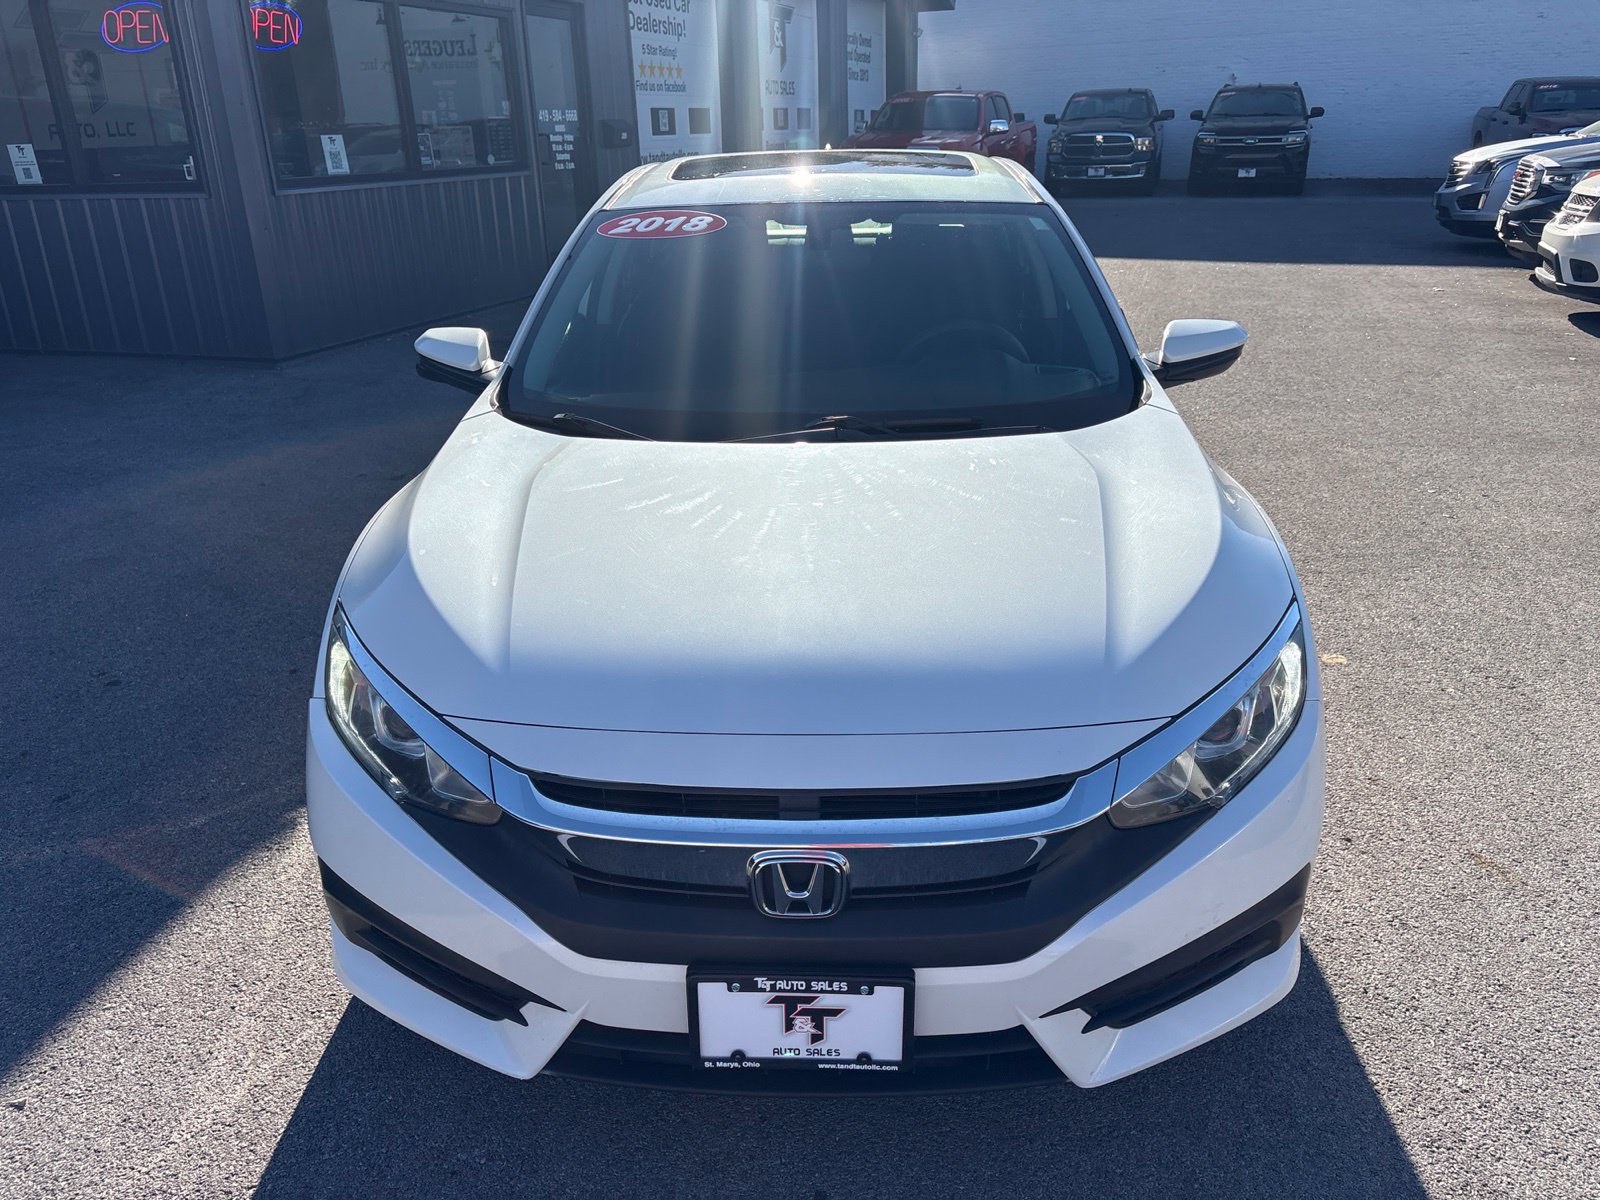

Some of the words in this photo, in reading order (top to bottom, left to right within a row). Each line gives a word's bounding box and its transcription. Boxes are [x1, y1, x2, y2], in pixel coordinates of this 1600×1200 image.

[103, 10, 169, 43] OPEN
[249, 8, 299, 45] PEN
[628, 10, 687, 41] Dealership!
[105, 121, 137, 138] LLC
[608, 216, 714, 235] 2018
[776, 979, 806, 991] AUTO
[810, 980, 848, 992] SALES
[772, 1047, 801, 1057] AUTO
[805, 1047, 841, 1057] SALES
[704, 1061, 714, 1069] St.
[716, 1061, 741, 1070] Marys,
[742, 1061, 761, 1069] Ohio
